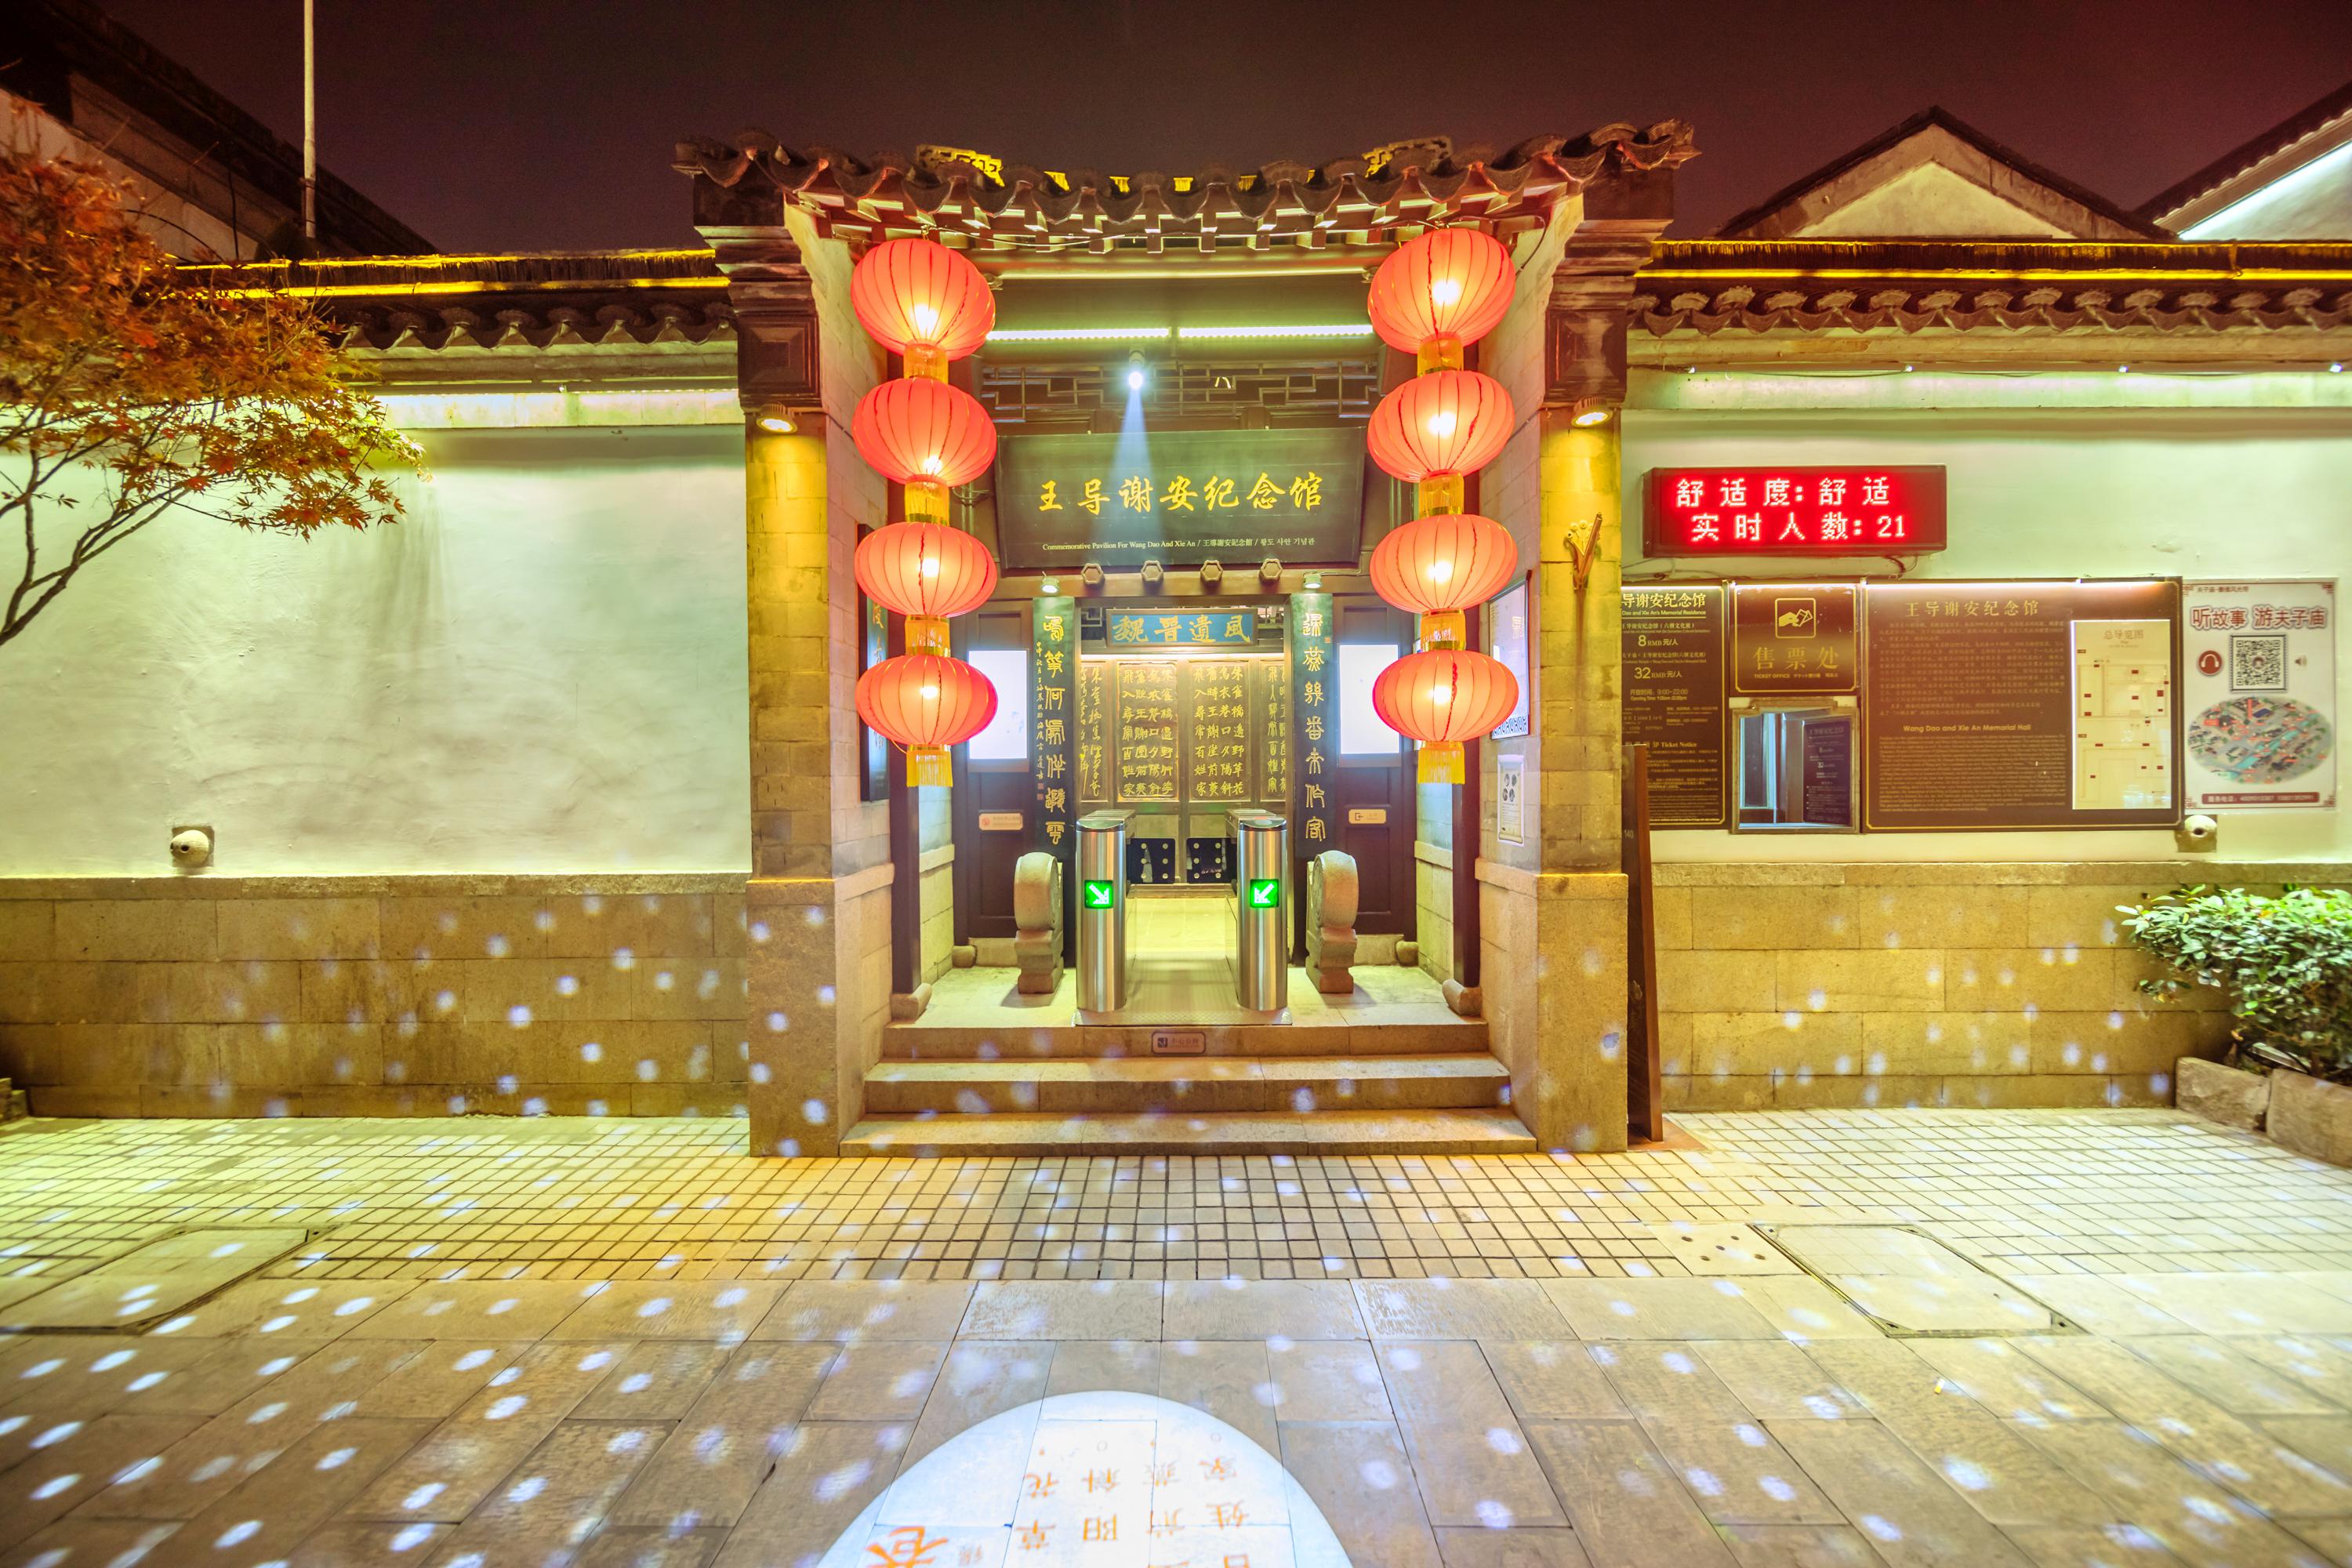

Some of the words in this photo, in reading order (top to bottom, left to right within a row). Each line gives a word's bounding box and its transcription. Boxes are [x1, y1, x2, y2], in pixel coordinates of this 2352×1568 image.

[1039, 472, 1323, 515] 王导谢安纪念馆
[1904, 600, 2038, 617] 王导谢安纪念馆
[2192, 607, 2246, 628] 听故事
[2254, 606, 2325, 627] 游夫子庙
[1638, 635, 1646, 647] 8
[1753, 646, 1838, 670] 售票处
[1634, 667, 1651, 679] 32
